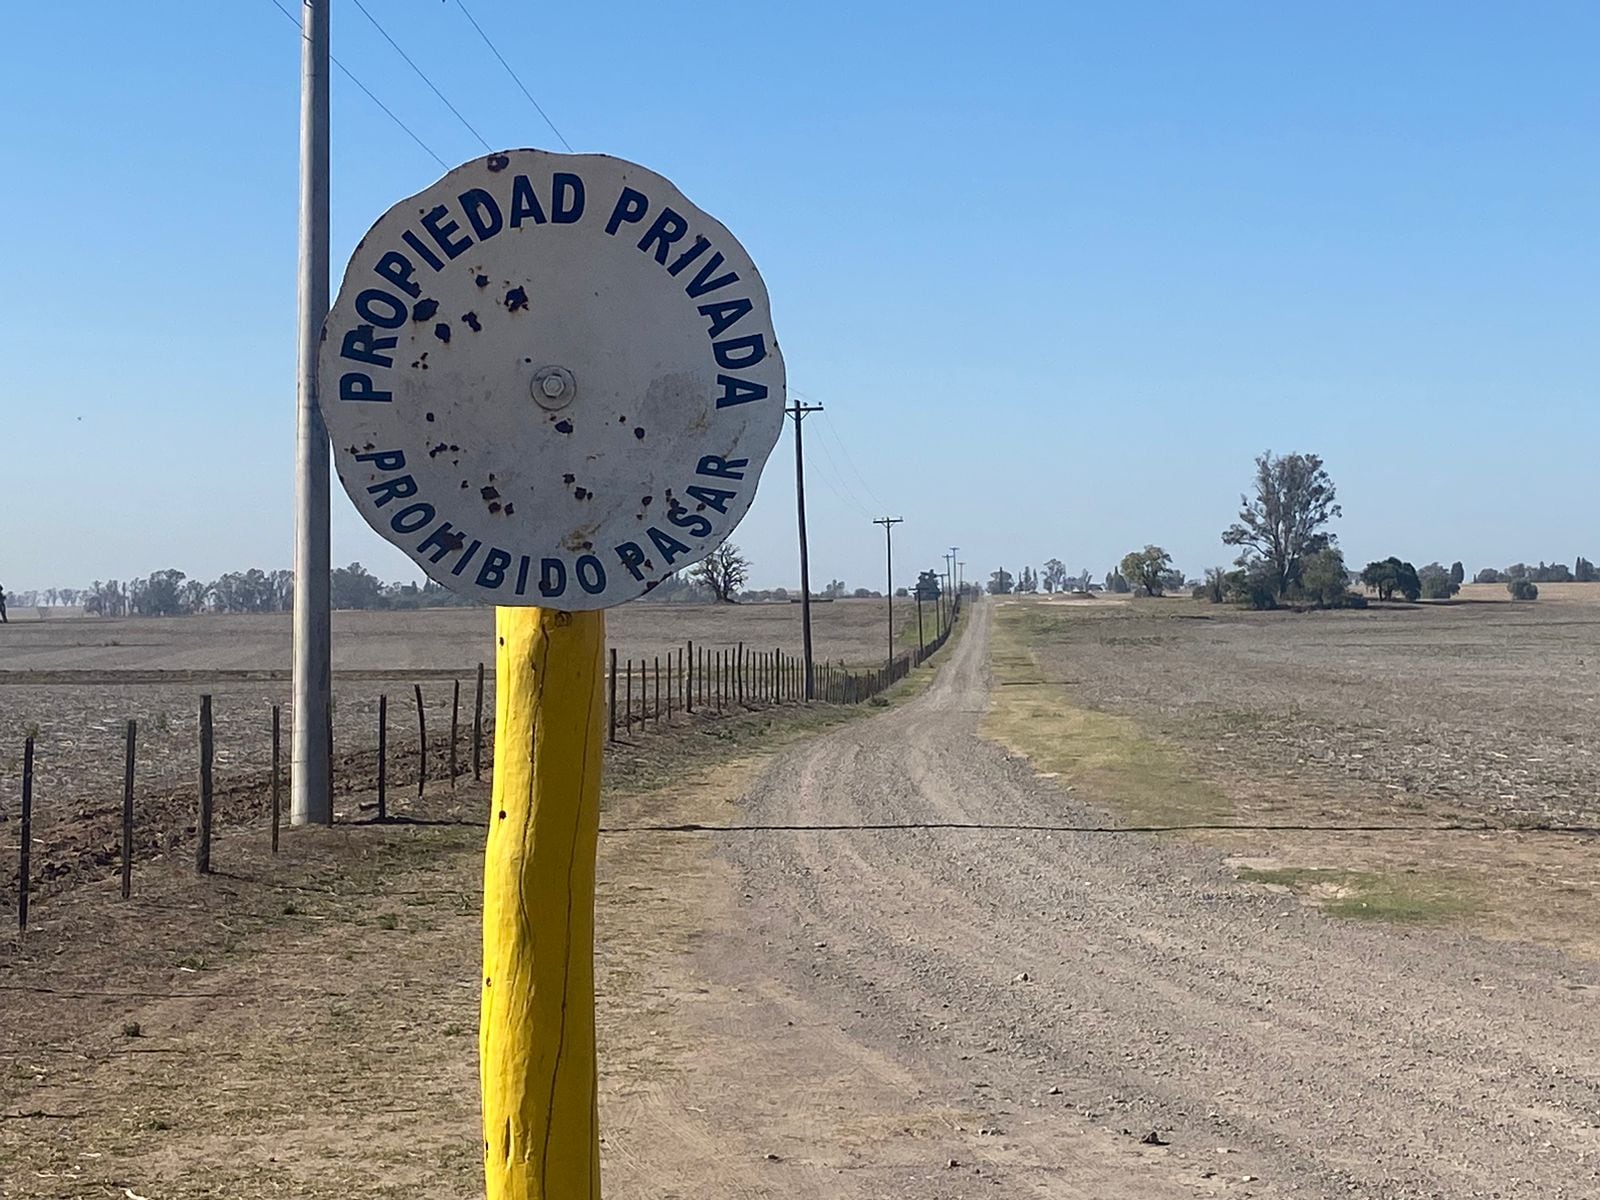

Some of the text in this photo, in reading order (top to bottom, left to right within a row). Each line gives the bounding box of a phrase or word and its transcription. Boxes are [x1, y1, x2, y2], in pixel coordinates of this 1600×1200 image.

[339, 173, 769, 410] PROPIEDAD PRIVADA
[355, 449, 749, 598] PROHIBIDO PASAR
